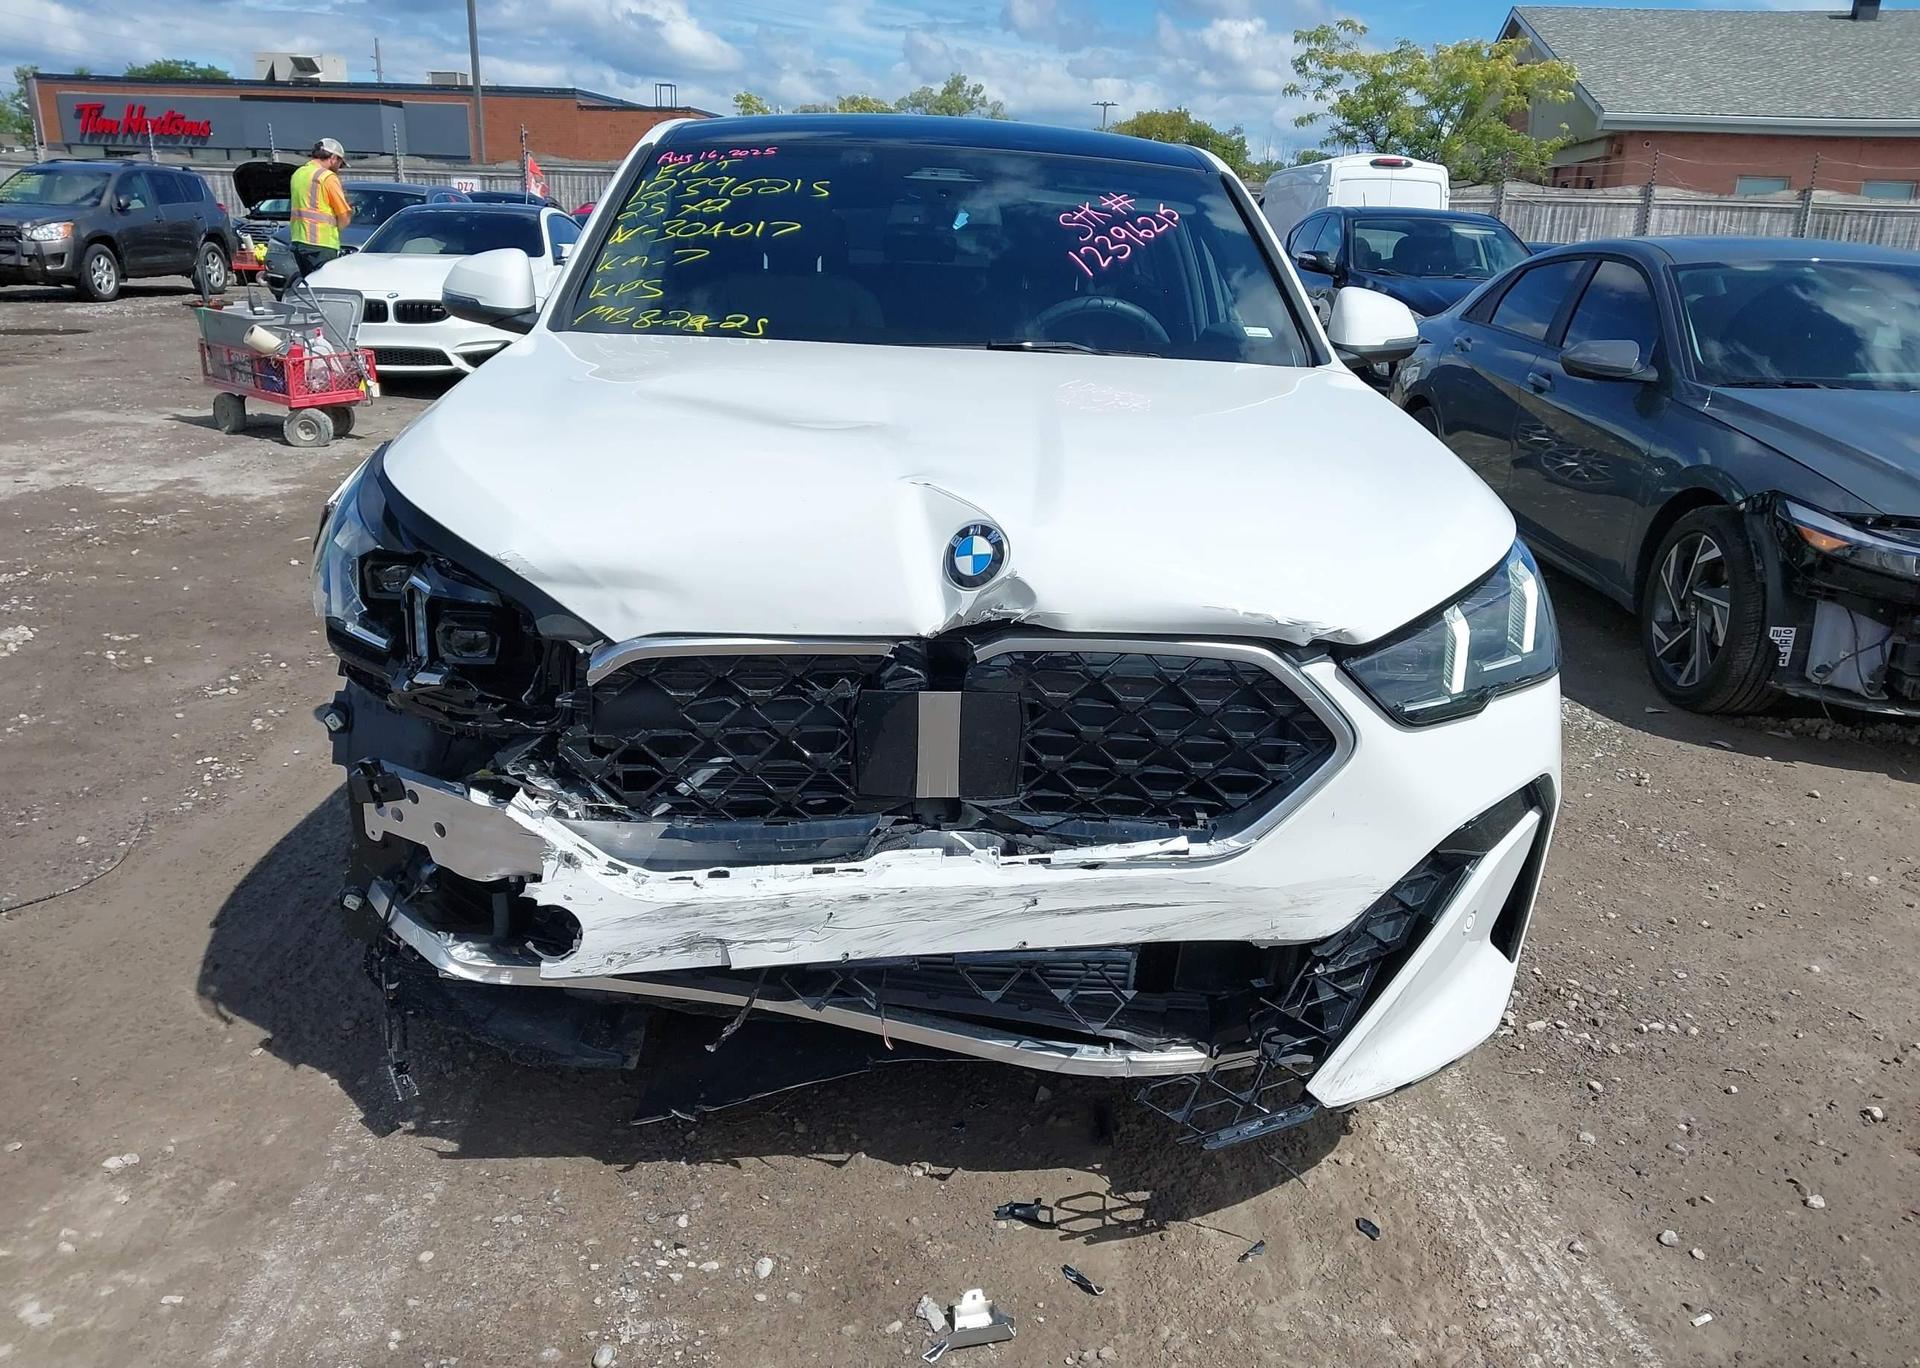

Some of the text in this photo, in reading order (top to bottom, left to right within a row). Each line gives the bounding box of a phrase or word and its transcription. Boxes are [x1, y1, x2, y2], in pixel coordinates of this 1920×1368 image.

[75, 103, 211, 136] Tim Hortons
[657, 151, 693, 164] Aug
[729, 146, 779, 156] 2025
[1067, 203, 1180, 277] 12396215
[950, 524, 1002, 548] BMW
